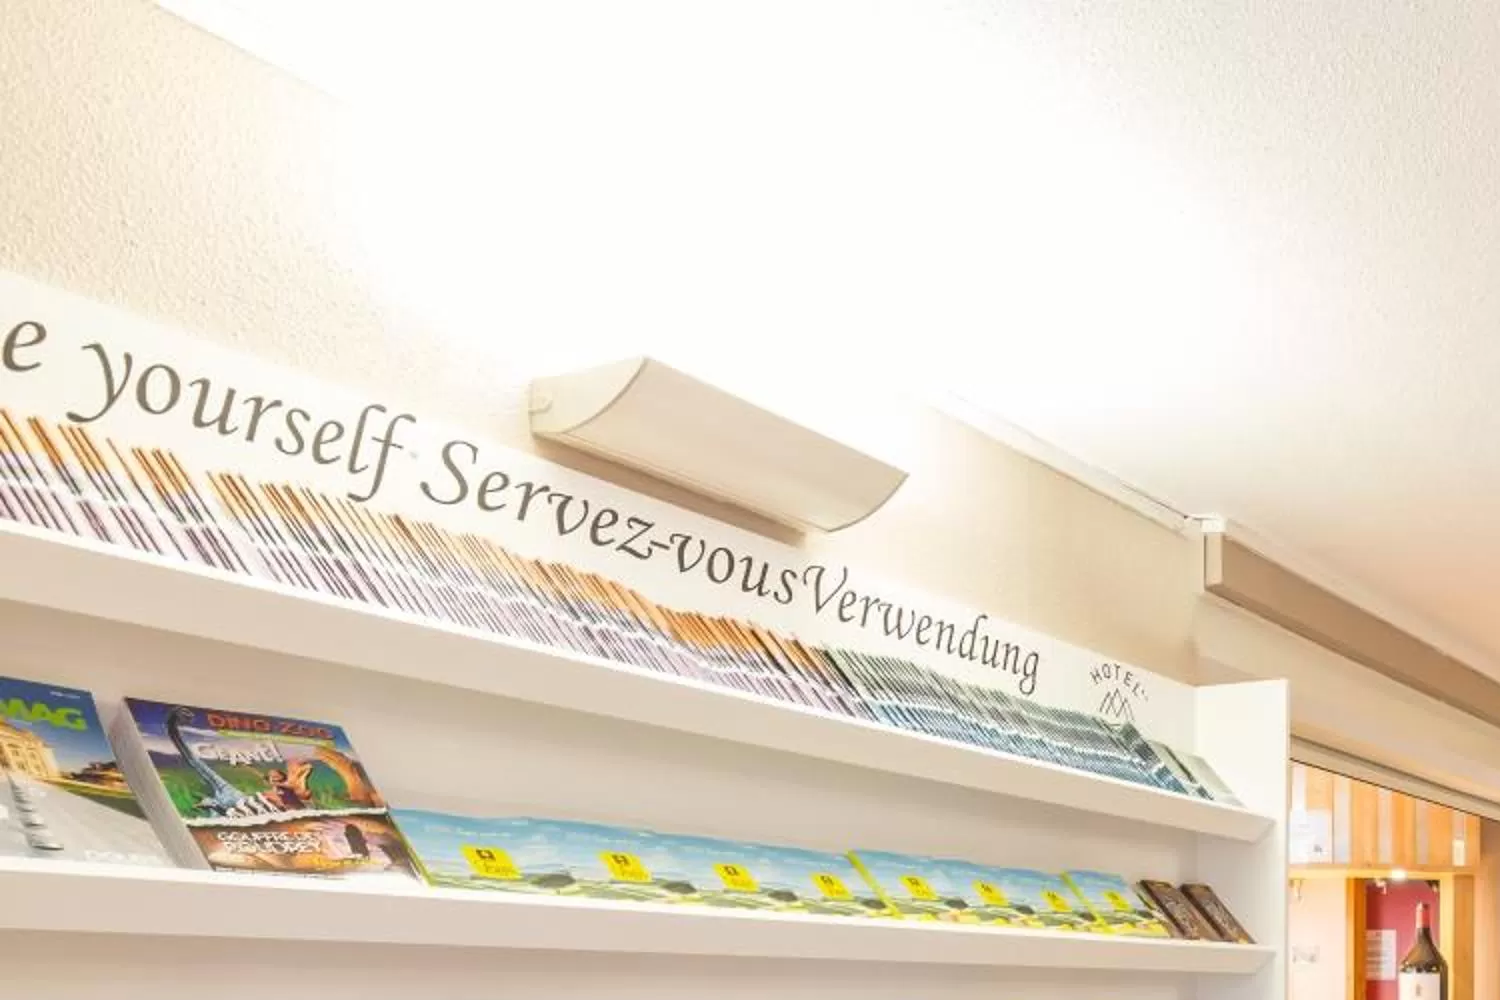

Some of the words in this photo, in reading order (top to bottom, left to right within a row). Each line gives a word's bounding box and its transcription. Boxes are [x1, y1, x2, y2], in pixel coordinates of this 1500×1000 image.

[66, 341, 417, 502] yourself
[420, 440, 799, 605] Servez-vous
[803, 565, 1039, 696] Verwendung
[207, 712, 270, 732] DINO
